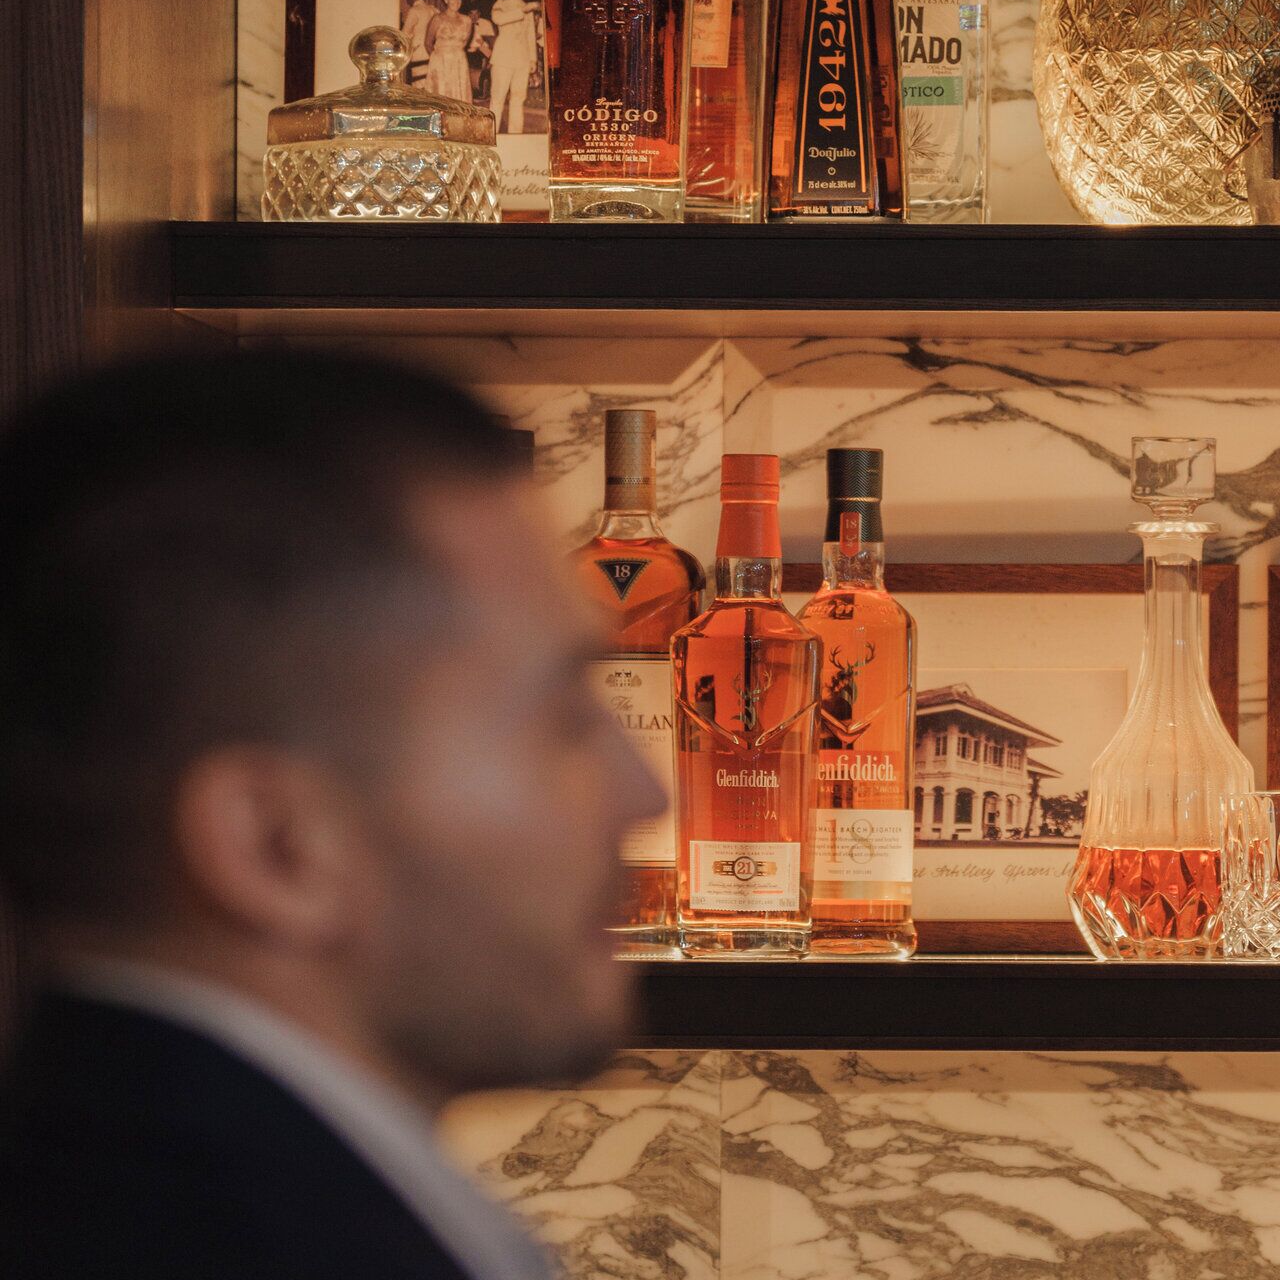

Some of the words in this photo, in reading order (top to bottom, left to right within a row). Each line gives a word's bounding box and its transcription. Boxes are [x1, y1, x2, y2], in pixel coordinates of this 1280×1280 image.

[901, 35, 962, 65] MADO
[819, 20, 847, 132] 1942
[903, 86, 945, 97] STICO
[564, 104, 659, 122] CÓDIGO
[582, 133, 637, 142] ORIGEN
[614, 564, 632, 578] 18
[817, 754, 897, 782] enfiddich.
[737, 861, 753, 875] 21
